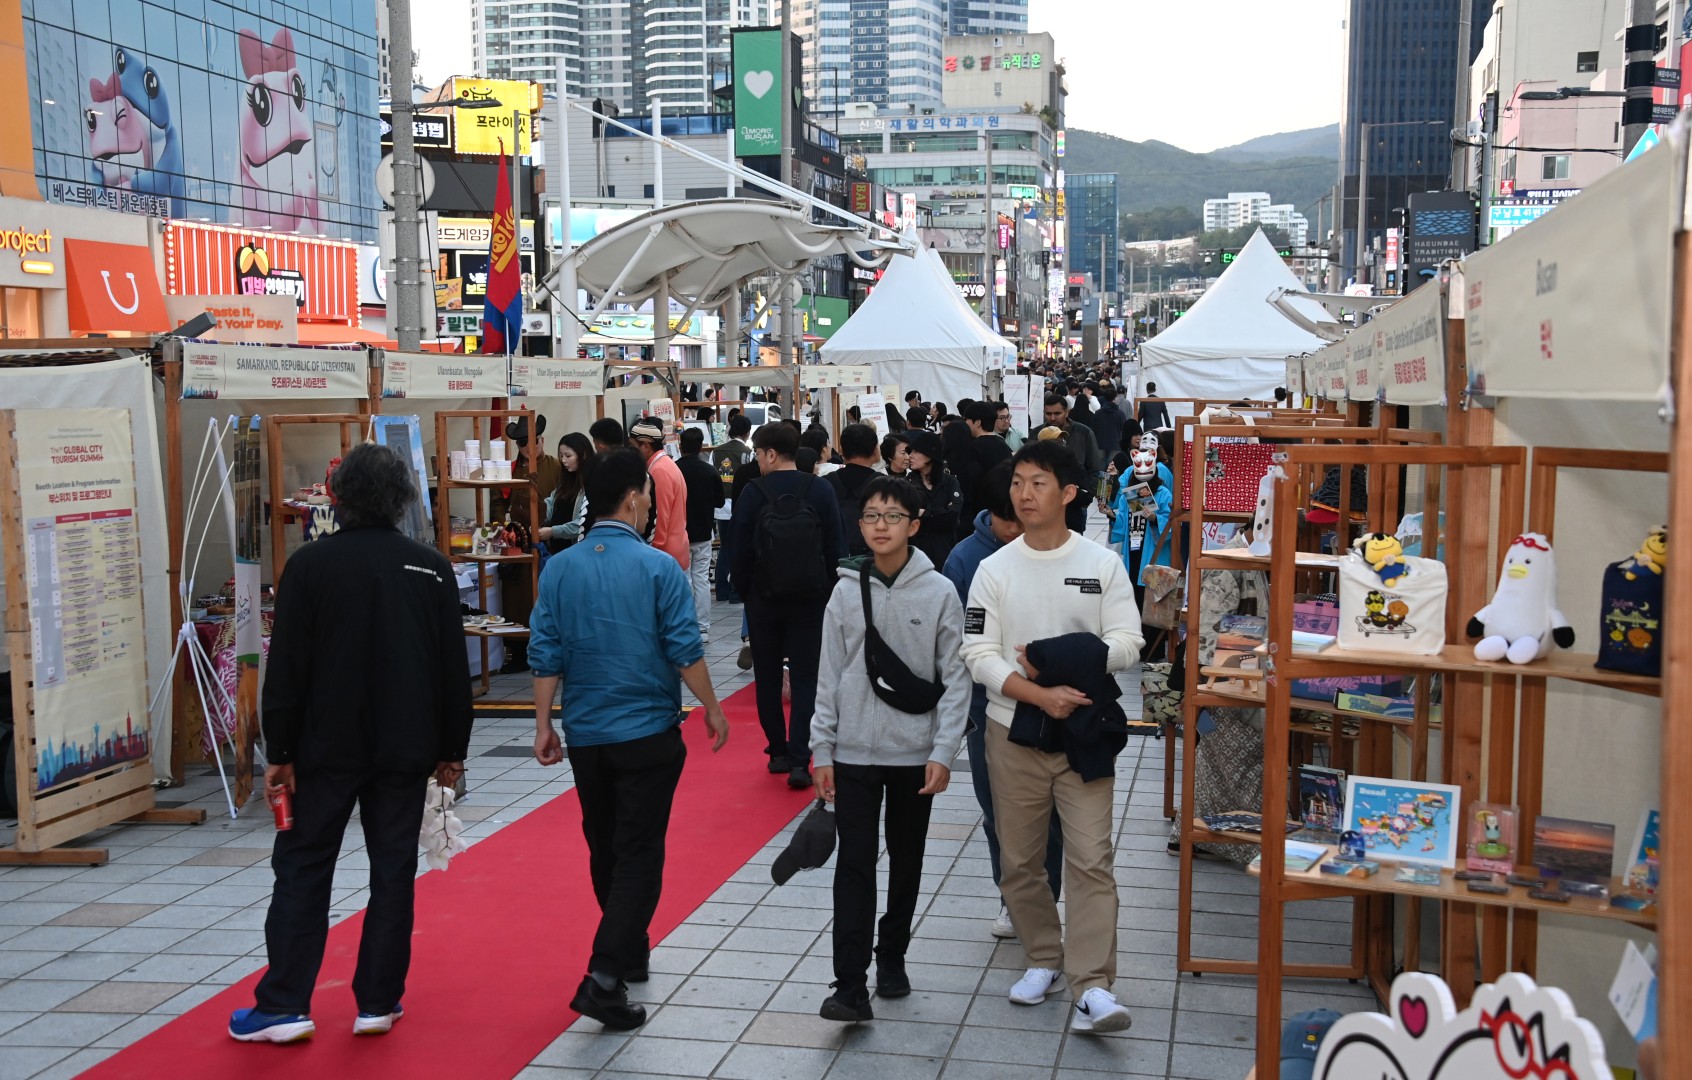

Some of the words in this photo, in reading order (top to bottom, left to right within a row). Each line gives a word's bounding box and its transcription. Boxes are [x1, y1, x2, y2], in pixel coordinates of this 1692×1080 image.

[859, 118, 886, 133] 신화
[889, 115, 999, 132] 재활의학과의원
[744, 133, 774, 141] BUSAN
[52, 183, 118, 210] 베스트웨스턴
[120, 192, 169, 218] 해운대호텔
[855, 184, 867, 211] BAR
[0, 226, 52, 257] project
[205, 307, 240, 318] Taste
[246, 307, 255, 318] It,
[225, 319, 252, 329] Your
[257, 319, 284, 331] Day.
[236, 357, 281, 372] SAMARKAND,
[281, 359, 310, 371] REPUBLIC
[311, 360, 320, 371] OF
[320, 360, 356, 373] UZBEKISTAN
[63, 446, 89, 455] GLOBAL
[90, 445, 103, 453] CITY
[51, 455, 79, 464] TOURISM
[35, 483, 52, 491] Booth
[76, 480, 95, 489] Program
[95, 478, 121, 486] Information
[49, 492, 72, 504] 부스위치
[72, 492, 78, 501] 및
[79, 489, 112, 501] 프로그램안내
